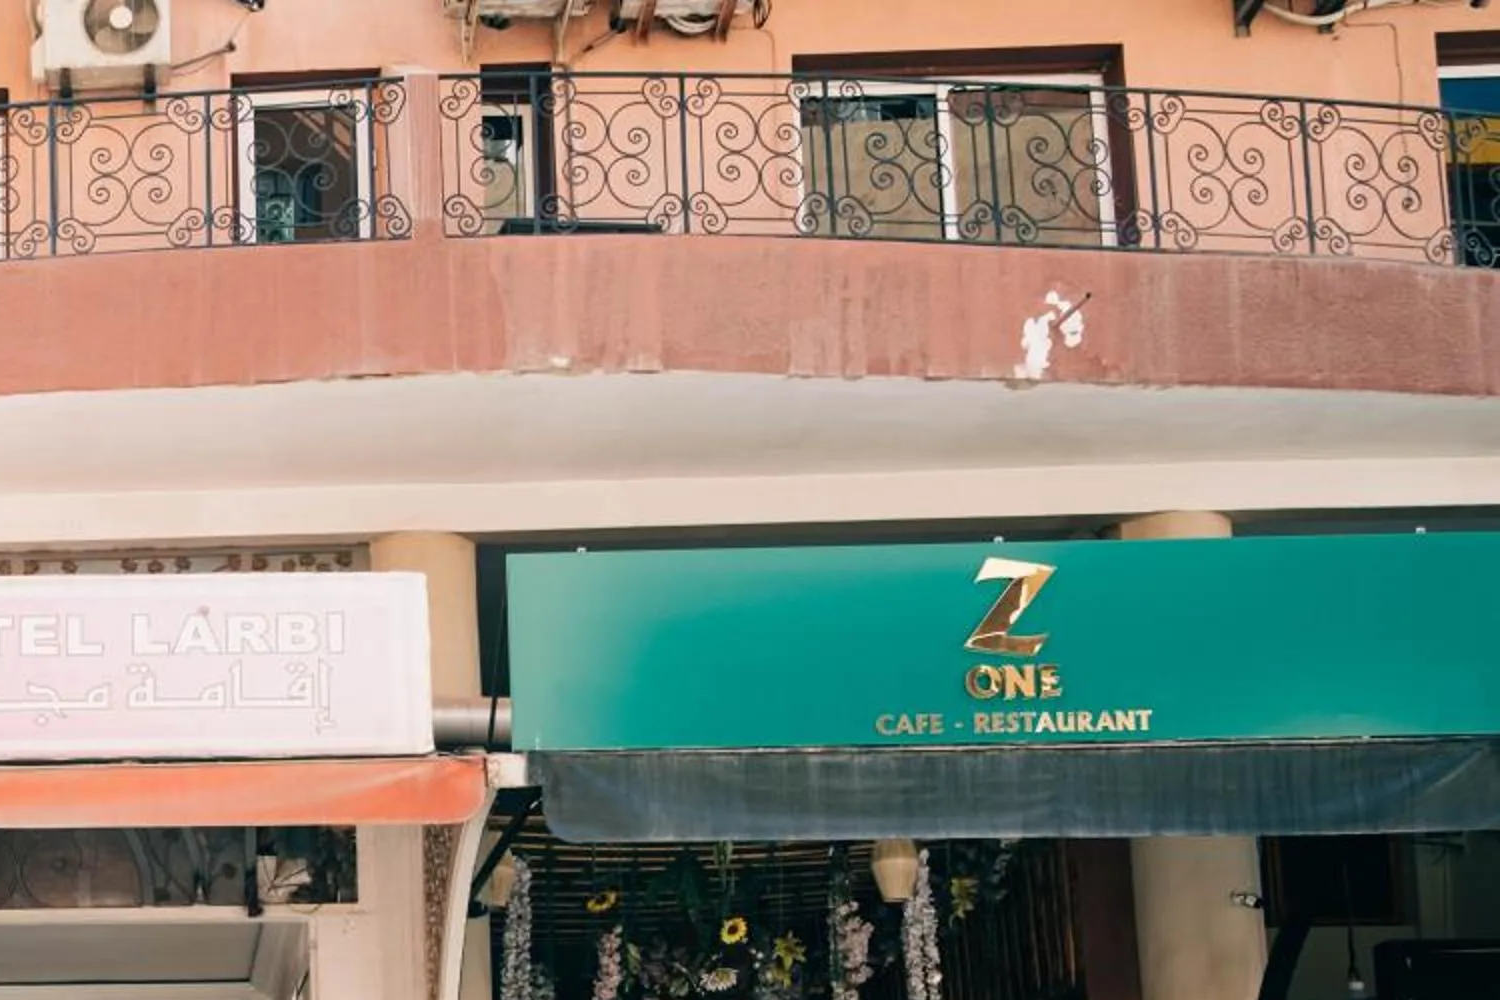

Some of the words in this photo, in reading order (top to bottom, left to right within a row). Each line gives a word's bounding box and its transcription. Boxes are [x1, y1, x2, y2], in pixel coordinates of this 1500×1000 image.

[130, 610, 345, 656] LARBI
[126, 657, 337, 735] إقامة
[964, 663, 1063, 700] ONE
[875, 712, 945, 736] CAFE
[973, 708, 1153, 735] RESTAURANT
